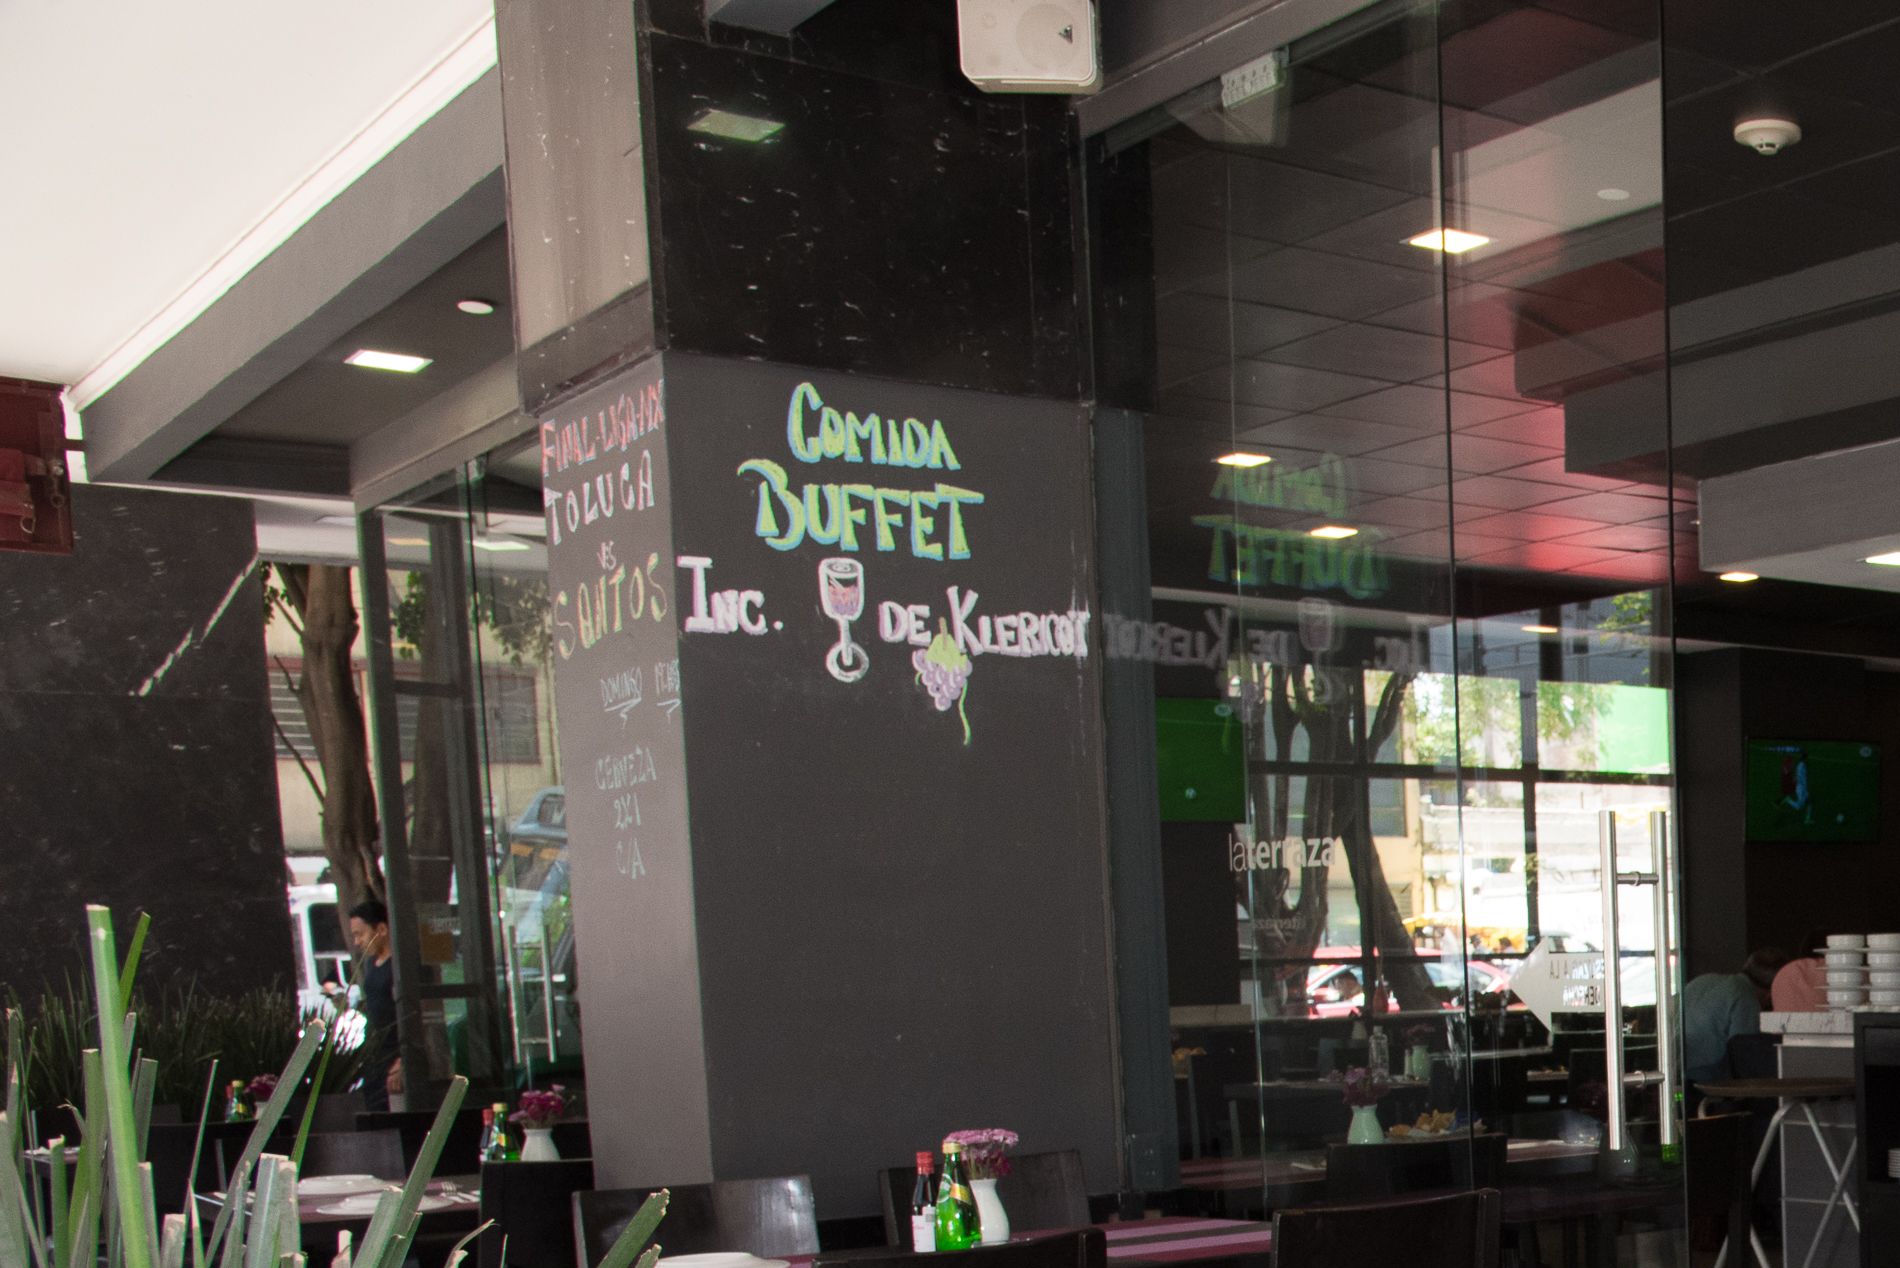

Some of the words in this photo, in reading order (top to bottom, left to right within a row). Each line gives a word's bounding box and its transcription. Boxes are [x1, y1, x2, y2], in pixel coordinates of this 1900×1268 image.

[787, 382, 962, 470] COMIDA
[543, 448, 656, 544] TOLUCA
[737, 459, 985, 561] BUFFET
[553, 552, 668, 660] SANTOS
[879, 600, 932, 647] DE
